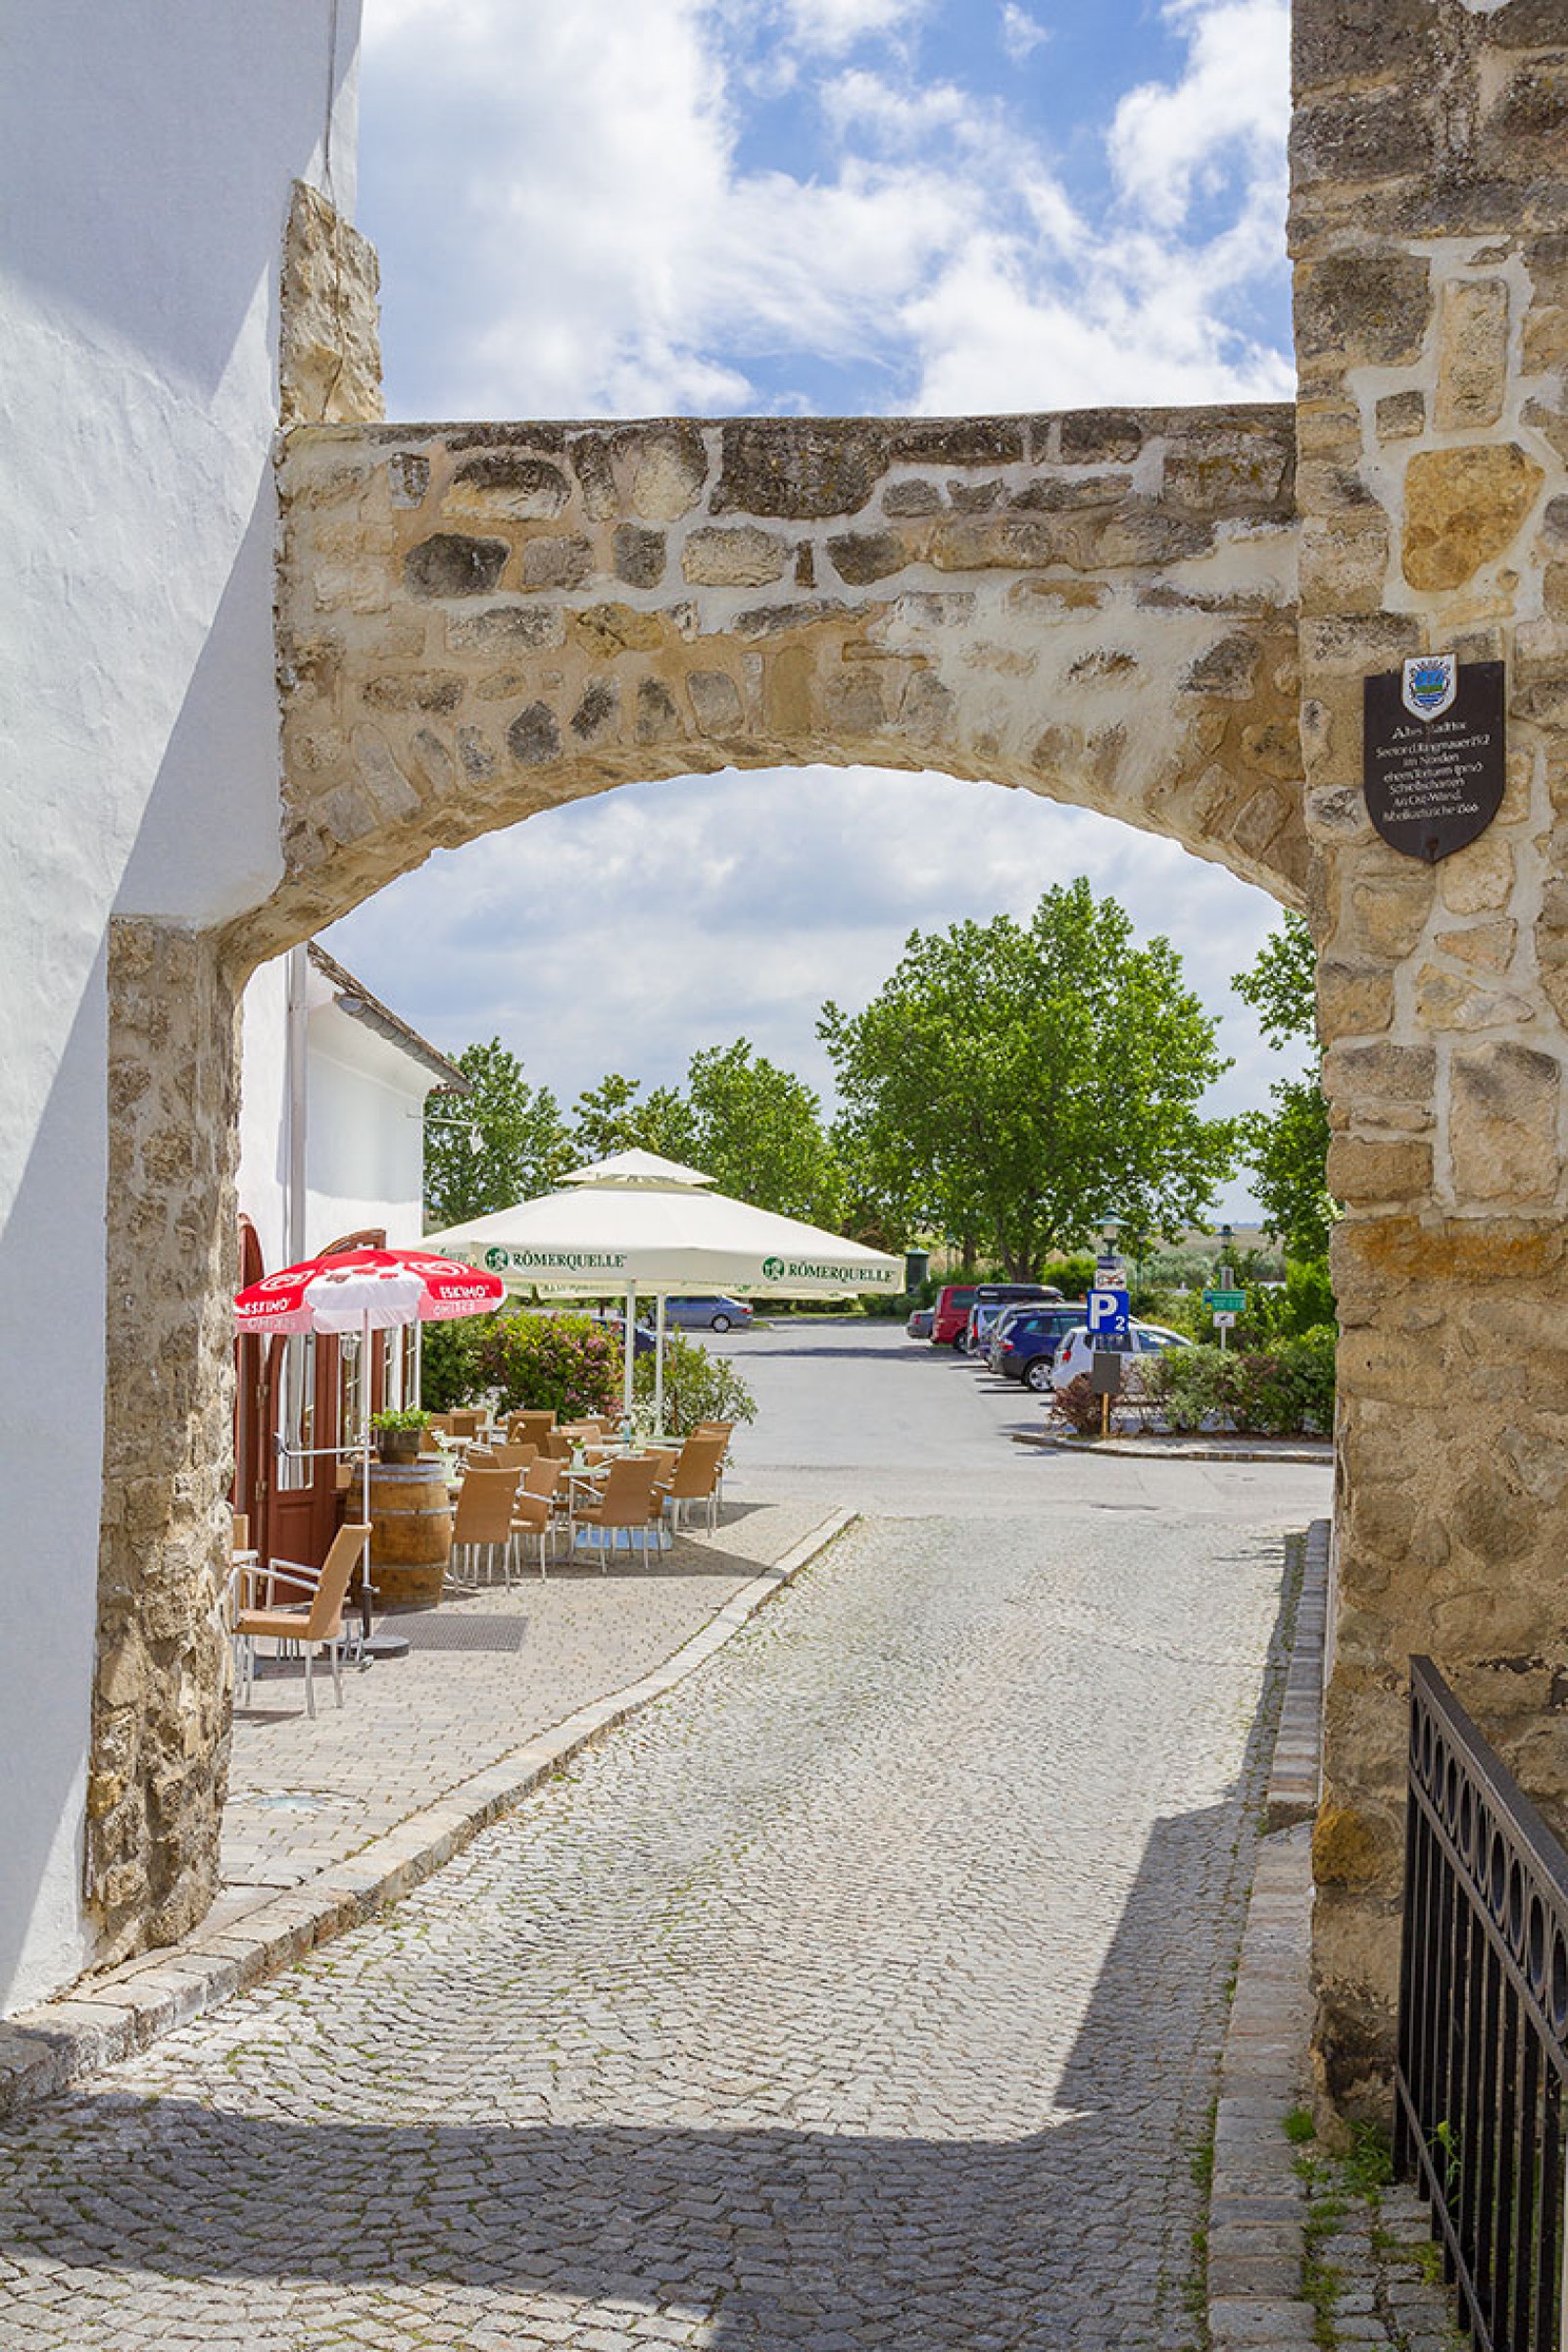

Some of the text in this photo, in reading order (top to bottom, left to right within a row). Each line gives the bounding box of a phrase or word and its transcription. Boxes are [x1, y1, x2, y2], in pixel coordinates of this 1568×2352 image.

[514, 1250, 624, 1271] RÖMERQUELLE
[789, 1260, 894, 1283] RÖMERQUELLE
[1091, 1293, 1125, 1331] P 2
